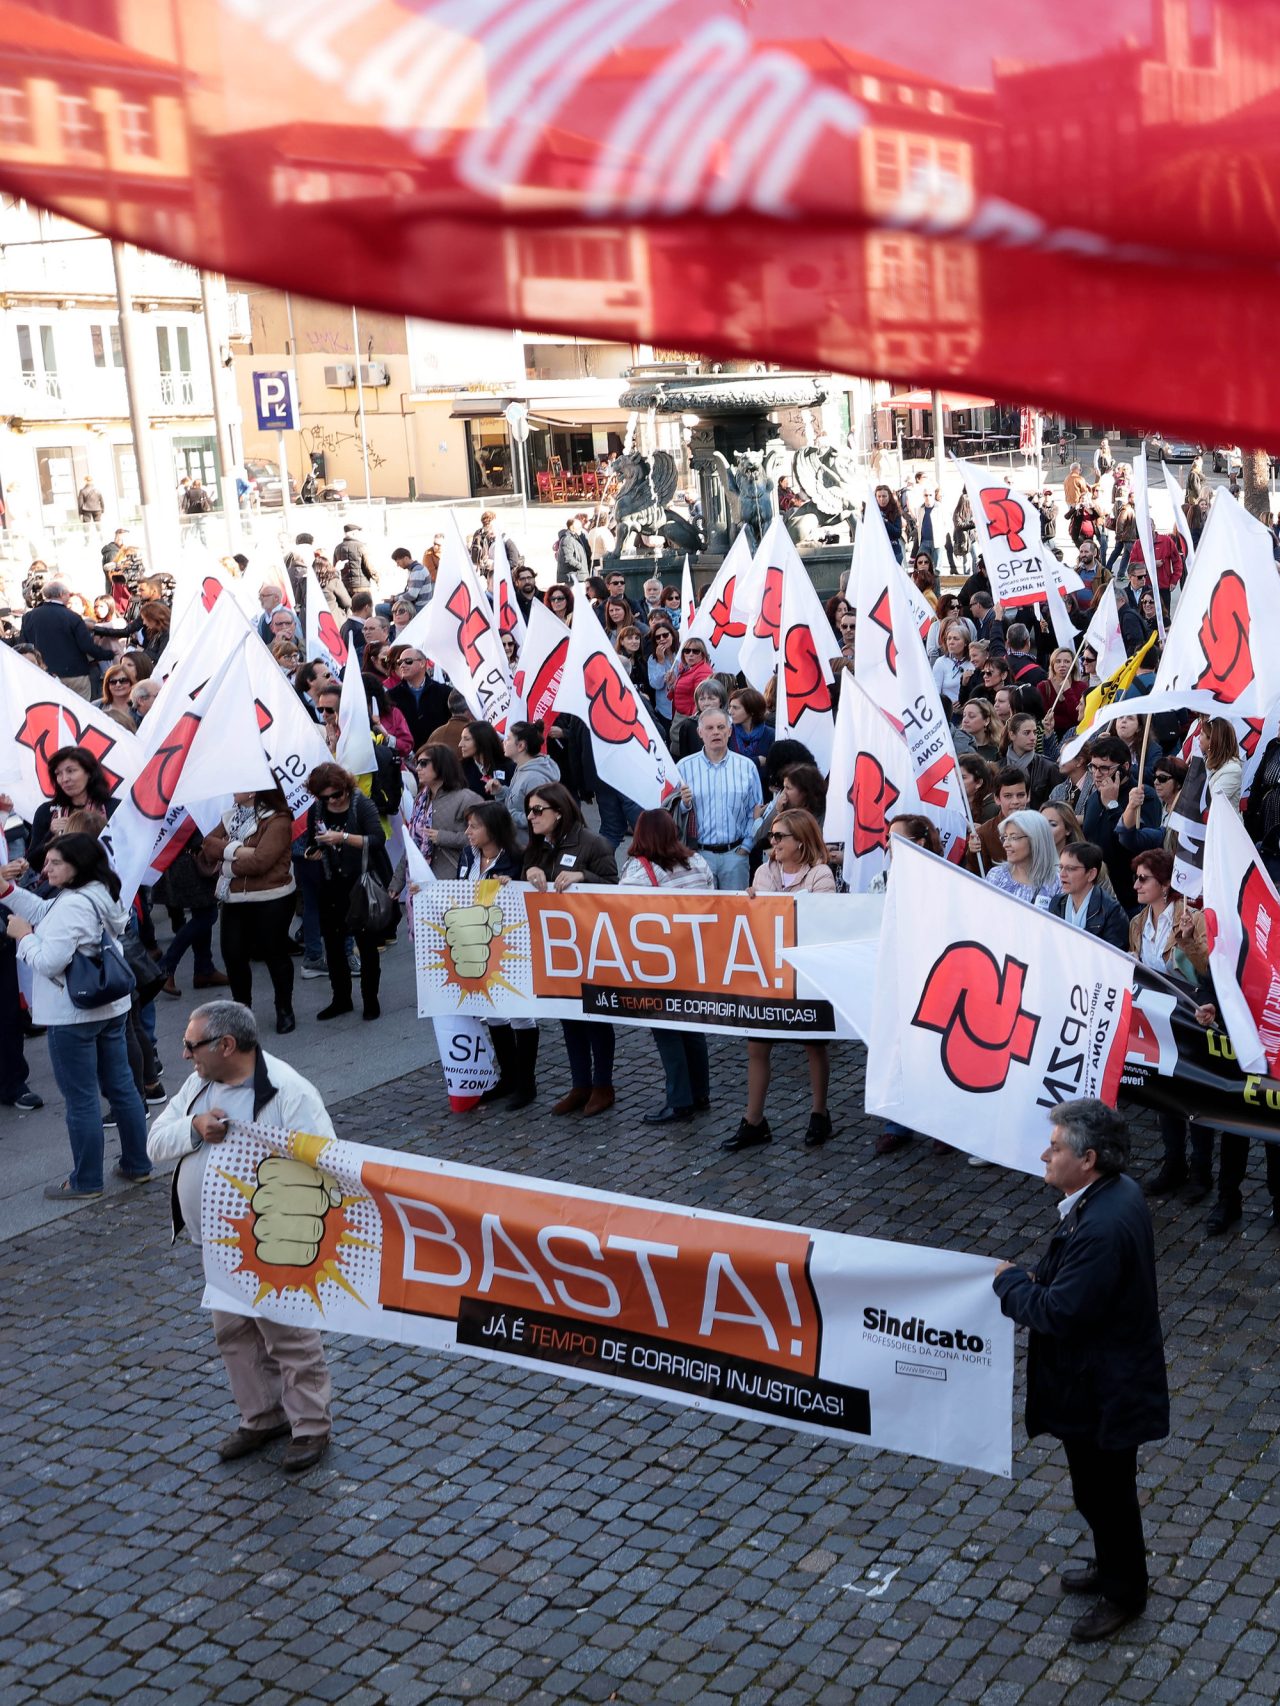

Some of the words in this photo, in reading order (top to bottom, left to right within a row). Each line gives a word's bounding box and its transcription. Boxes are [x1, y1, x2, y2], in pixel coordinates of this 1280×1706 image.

[259, 377, 286, 418] P
[1011, 584, 1034, 593] ZONA
[538, 908, 785, 989] BASTA!
[595, 992, 609, 1008] JÁ
[610, 992, 619, 1008] É
[620, 995, 664, 1012] TEMPO
[665, 998, 682, 1013] DE
[684, 999, 736, 1018] CORRIGIR
[737, 1002, 818, 1025] INJUSTIÇAS!
[383, 1192, 804, 1358] BASTA!
[862, 1306, 985, 1353] Sindicato
[862, 1331, 918, 1354] PROFESSORES
[918, 1345, 932, 1357] DA
[933, 1348, 960, 1361] ZONA
[961, 1353, 993, 1367] NORTE
[481, 1313, 508, 1340] JÁ
[511, 1314, 526, 1342] É
[528, 1322, 597, 1357] TEMPO
[600, 1337, 627, 1365] DE
[630, 1344, 722, 1387] CORRIGIR
[725, 1367, 846, 1417] INJUSTIÇAS!
